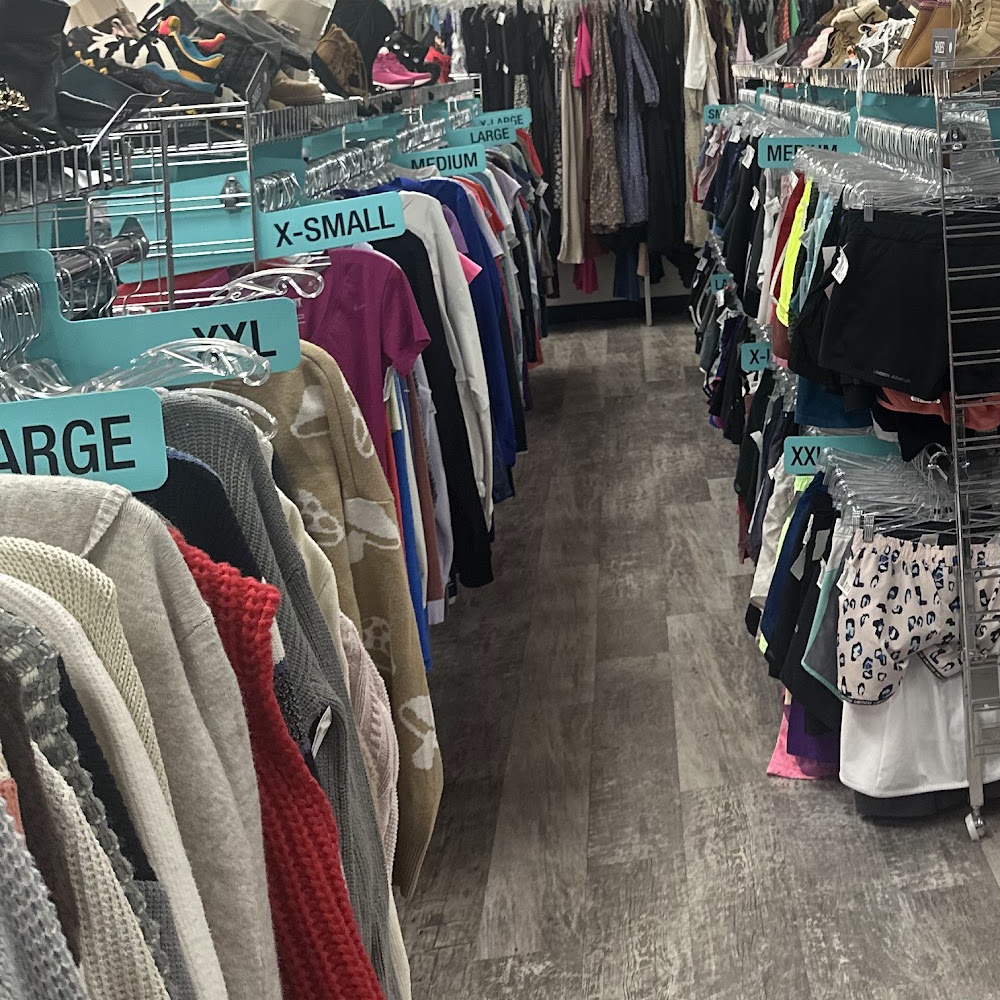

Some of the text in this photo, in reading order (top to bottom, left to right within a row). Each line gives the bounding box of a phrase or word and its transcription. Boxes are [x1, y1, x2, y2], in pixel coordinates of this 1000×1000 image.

[470, 128, 510, 144] LARGE
[411, 152, 478, 171] MEDIUM
[767, 144, 837, 162] MED
[274, 206, 395, 248] X-SMALL
